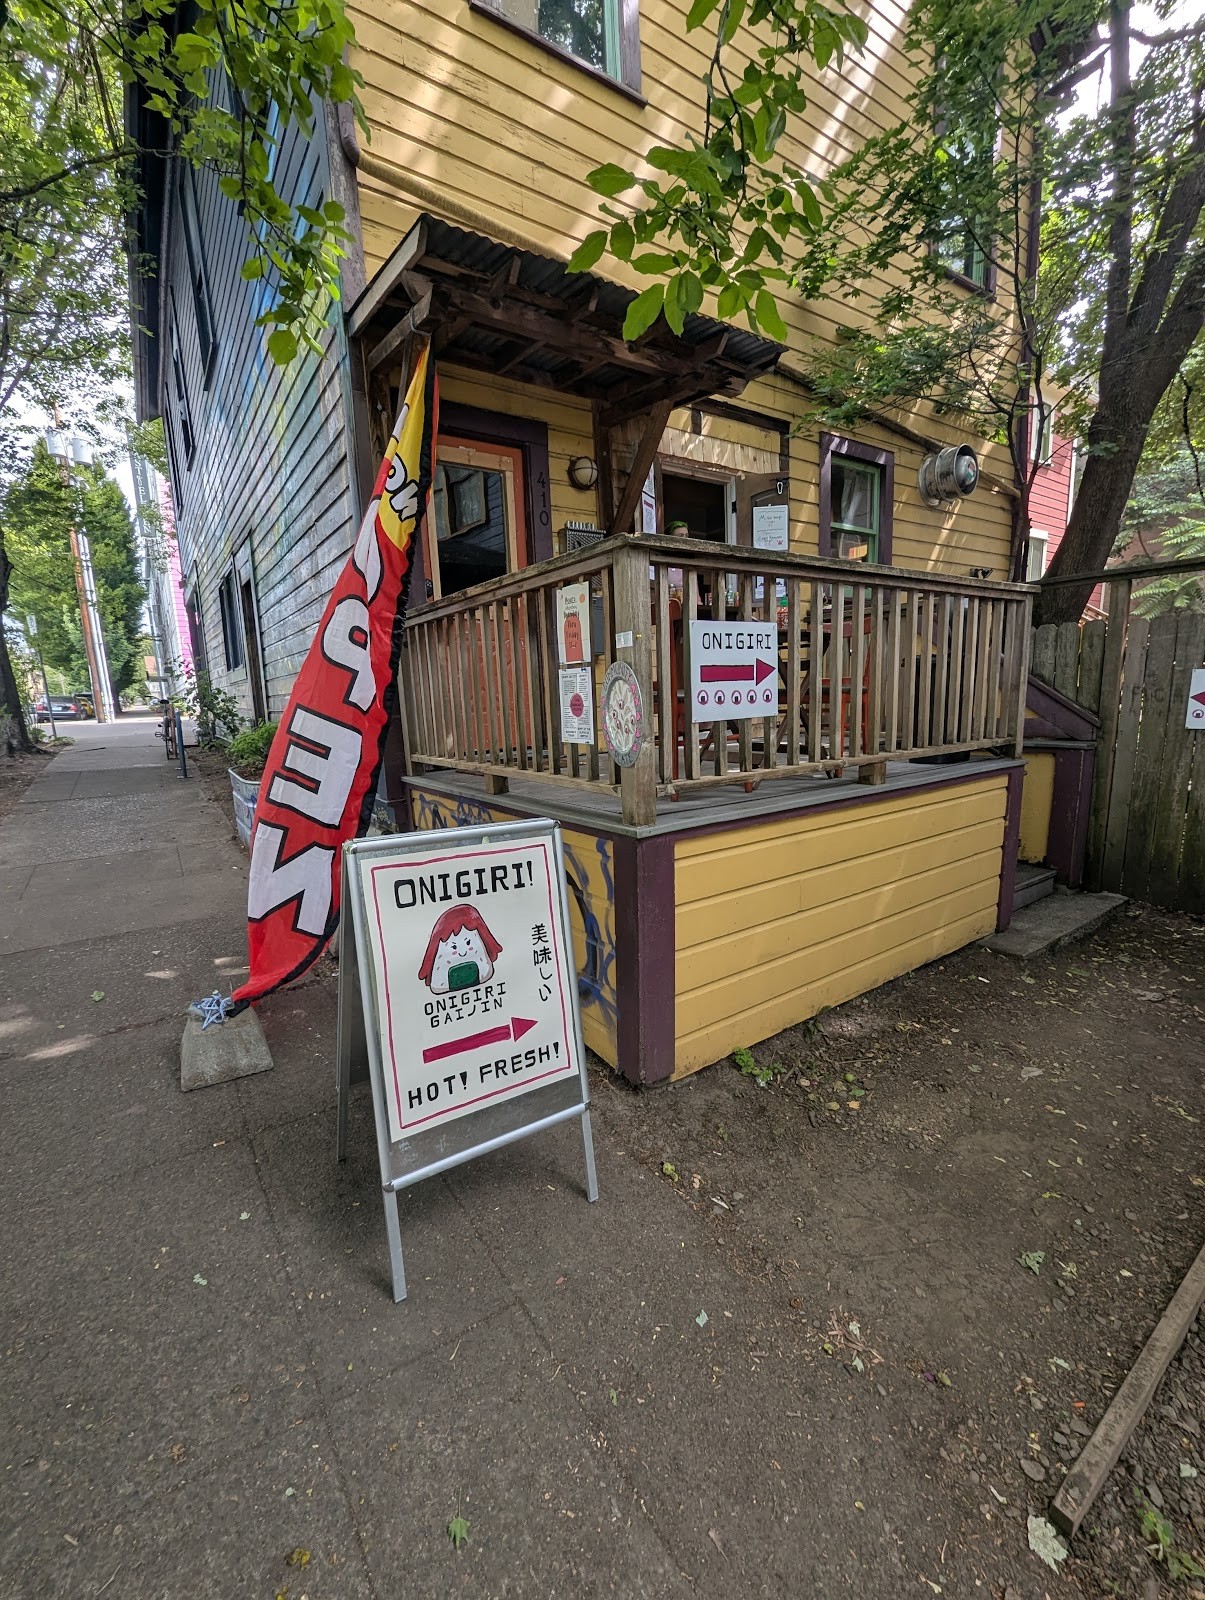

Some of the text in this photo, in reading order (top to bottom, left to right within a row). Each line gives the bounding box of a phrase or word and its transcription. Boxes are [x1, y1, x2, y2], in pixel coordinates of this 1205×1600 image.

[536, 471, 549, 526] 410
[702, 632, 772, 650] ONIGIRI
[393, 860, 534, 908] ONIGIRI!
[531, 923, 553, 1002] 美味しい
[424, 982, 507, 1016] ONIGIRI
[430, 997, 503, 1028] GAIJIN
[407, 1041, 560, 1109] HOT! FRESH!
